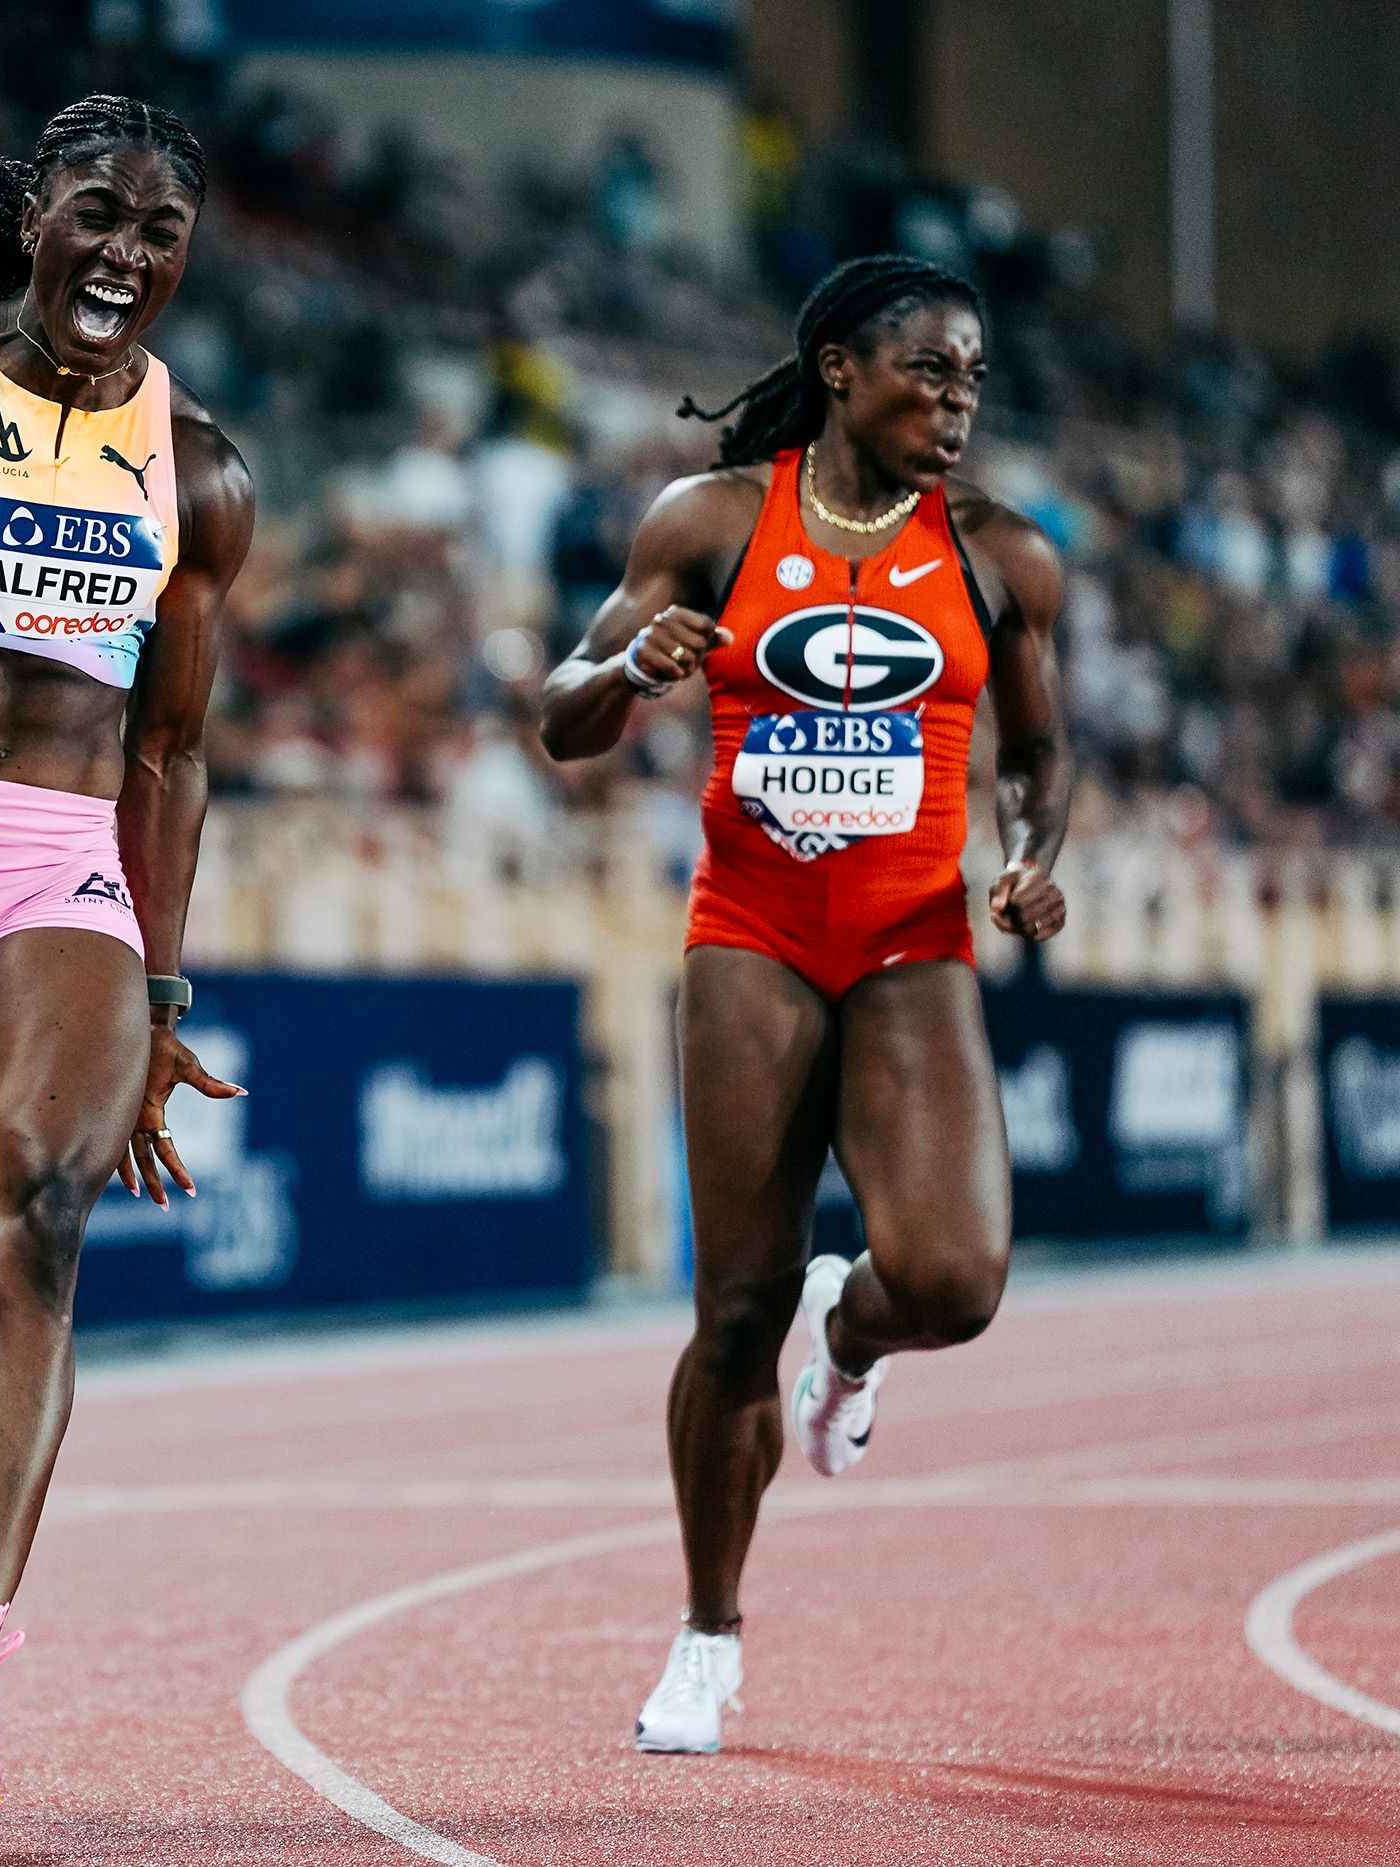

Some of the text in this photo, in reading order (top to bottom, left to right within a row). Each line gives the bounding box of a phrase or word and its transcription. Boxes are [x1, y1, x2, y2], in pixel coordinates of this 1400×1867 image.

[51, 514, 132, 558] EBS
[15, 611, 130, 635] ooredoo
[813, 716, 893, 753] EBS
[762, 766, 895, 795] HODGE
[792, 805, 905, 828] ooredoo
[64, 897, 104, 905] SAINT
